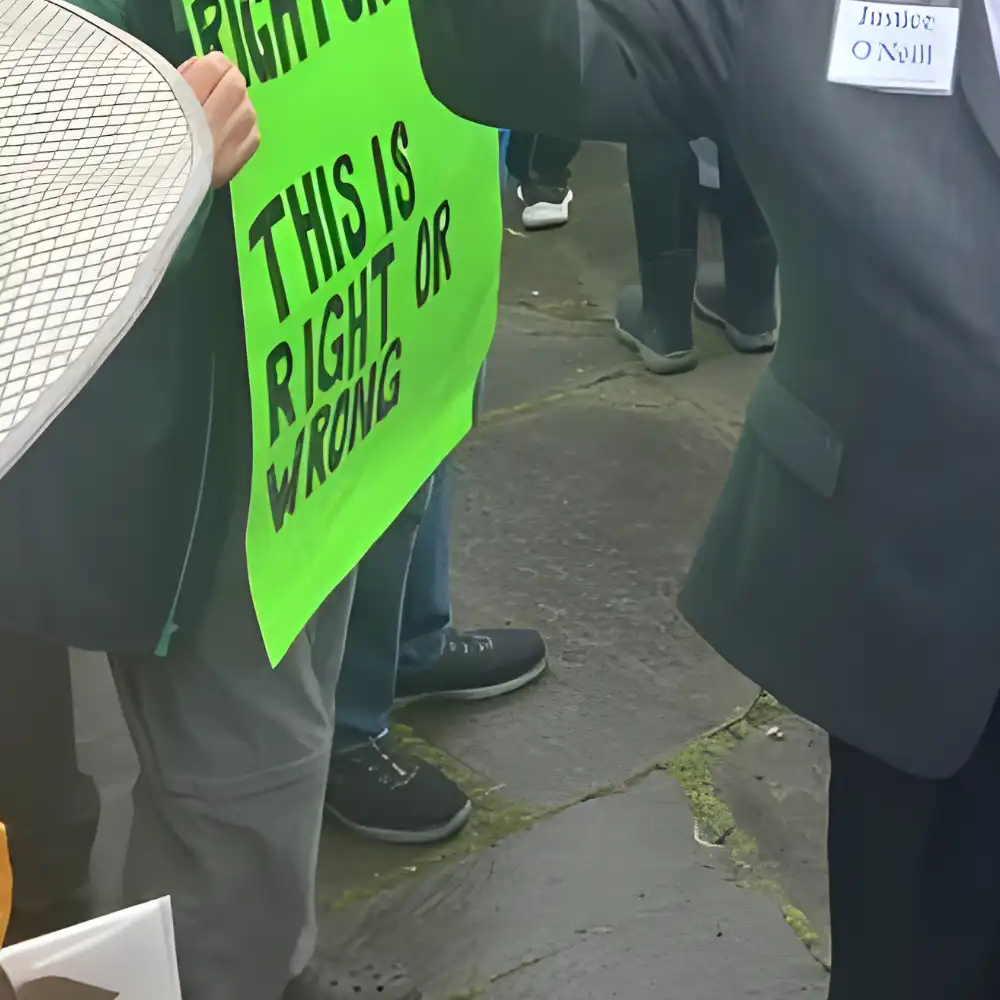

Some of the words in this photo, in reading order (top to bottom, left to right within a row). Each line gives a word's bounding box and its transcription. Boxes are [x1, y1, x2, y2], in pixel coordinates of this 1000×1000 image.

[248, 153, 368, 324] THIS
[371, 119, 417, 235] IS
[265, 242, 396, 449] RIGHT
[415, 199, 452, 310] OR
[266, 336, 402, 535] WRONG
